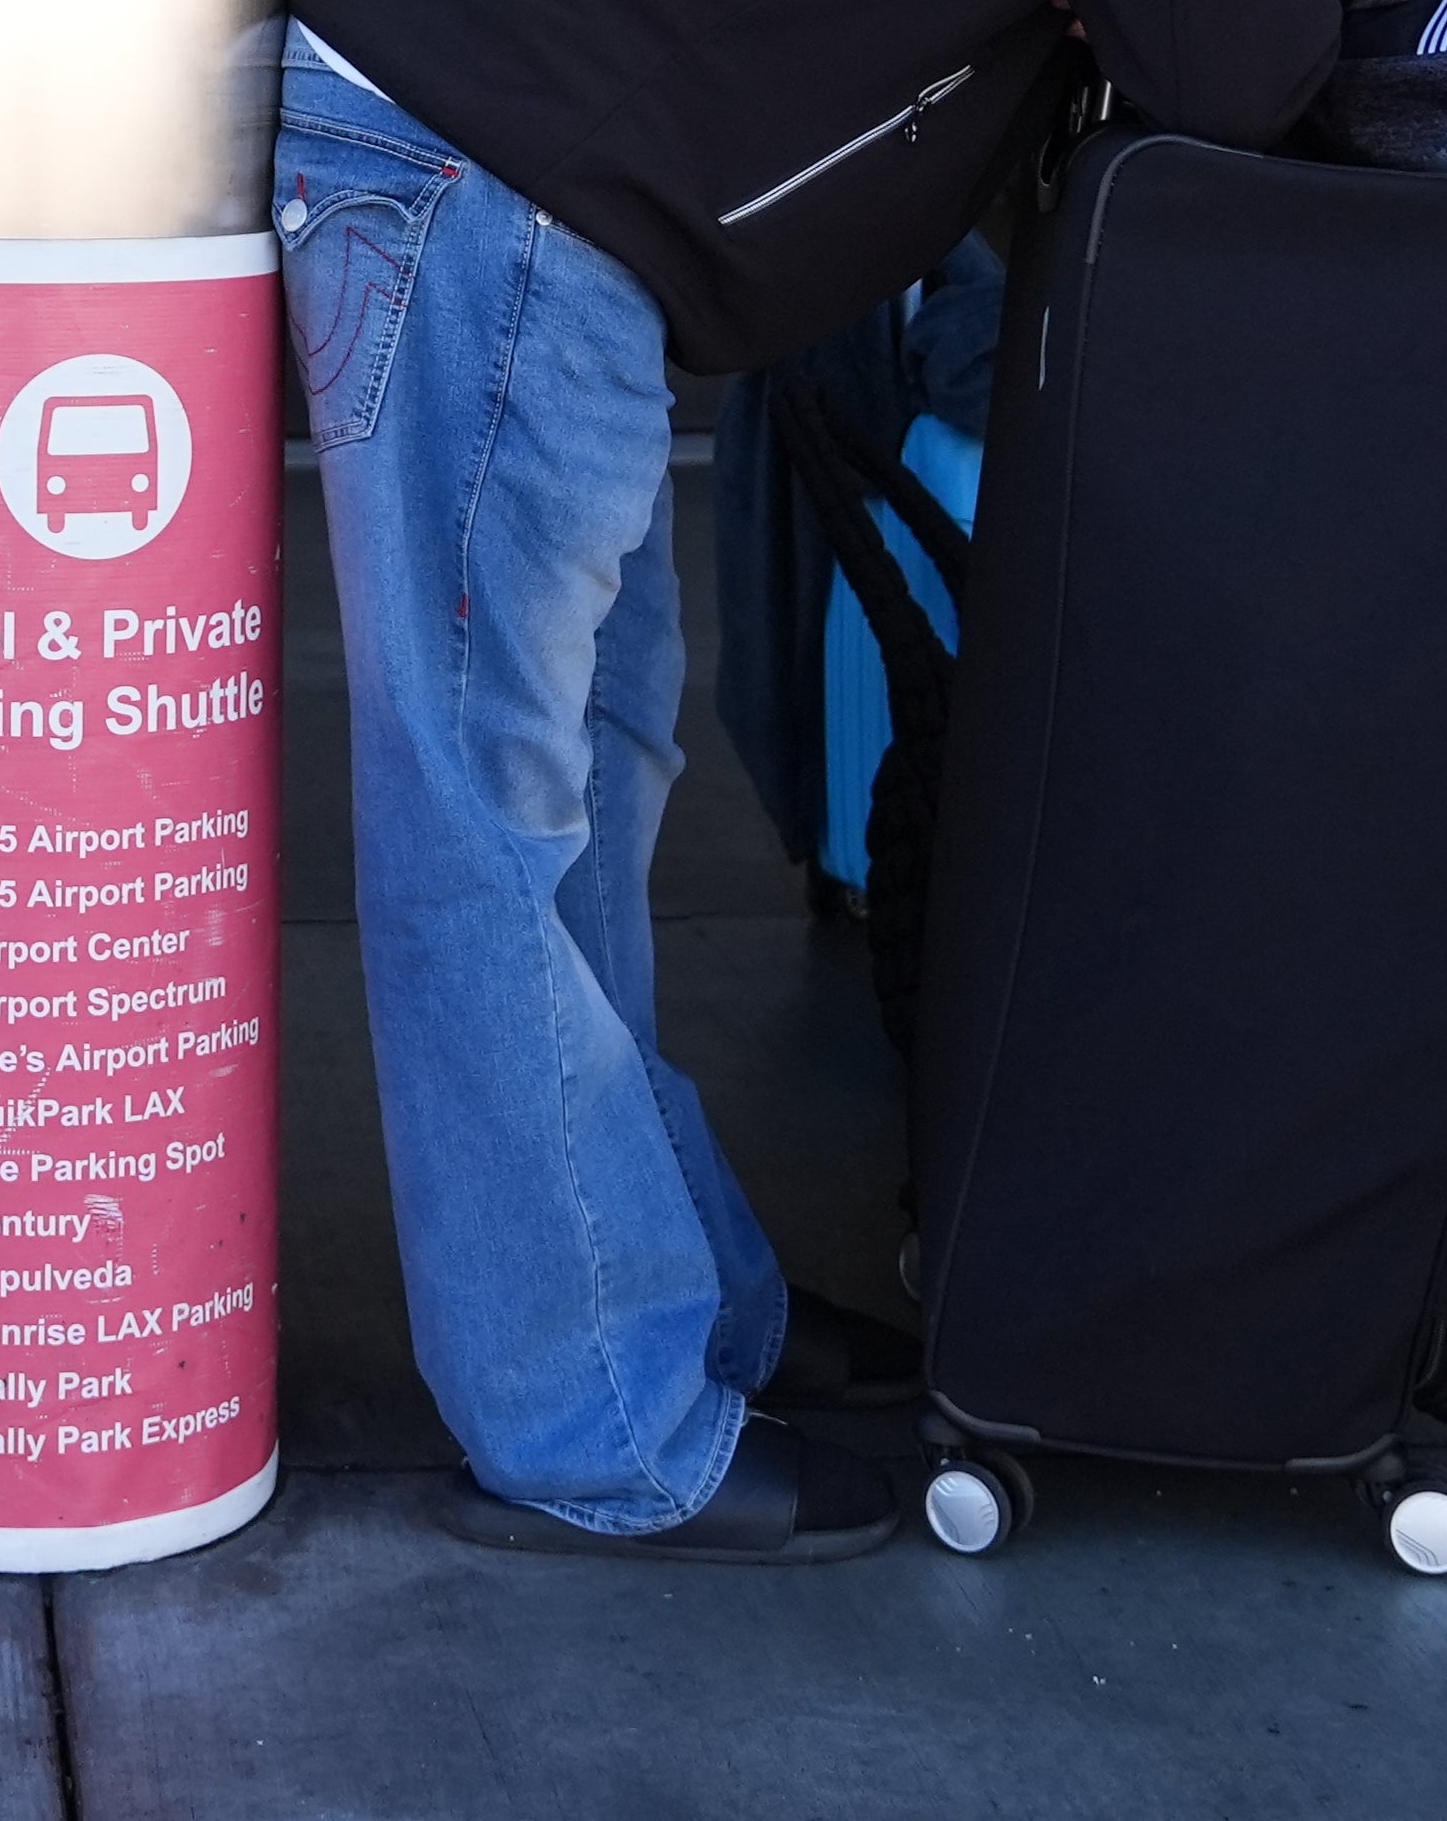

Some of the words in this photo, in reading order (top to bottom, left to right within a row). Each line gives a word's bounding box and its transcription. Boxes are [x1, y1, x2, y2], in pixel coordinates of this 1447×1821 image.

[36, 610, 83, 660] &
[103, 599, 263, 658] Private
[105, 671, 264, 737] Shuttle
[28, 822, 146, 858] Airport
[153, 809, 249, 849] Parking
[27, 877, 146, 913] Airport
[153, 862, 248, 903] Parking
[87, 927, 190, 962] Center
[86, 974, 227, 1020] Spectrum
[55, 1038, 169, 1076] Airport
[177, 1014, 260, 1058] Parking
[123, 1087, 186, 1124] LAX
[31, 1149, 157, 1184] Parking
[166, 1132, 226, 1173] Spot
[97, 1307, 162, 1343] LAX
[170, 1282, 256, 1332] Parking
[57, 1366, 133, 1400] Park
[57, 1422, 132, 1456] Park
[140, 1394, 240, 1447] Express
